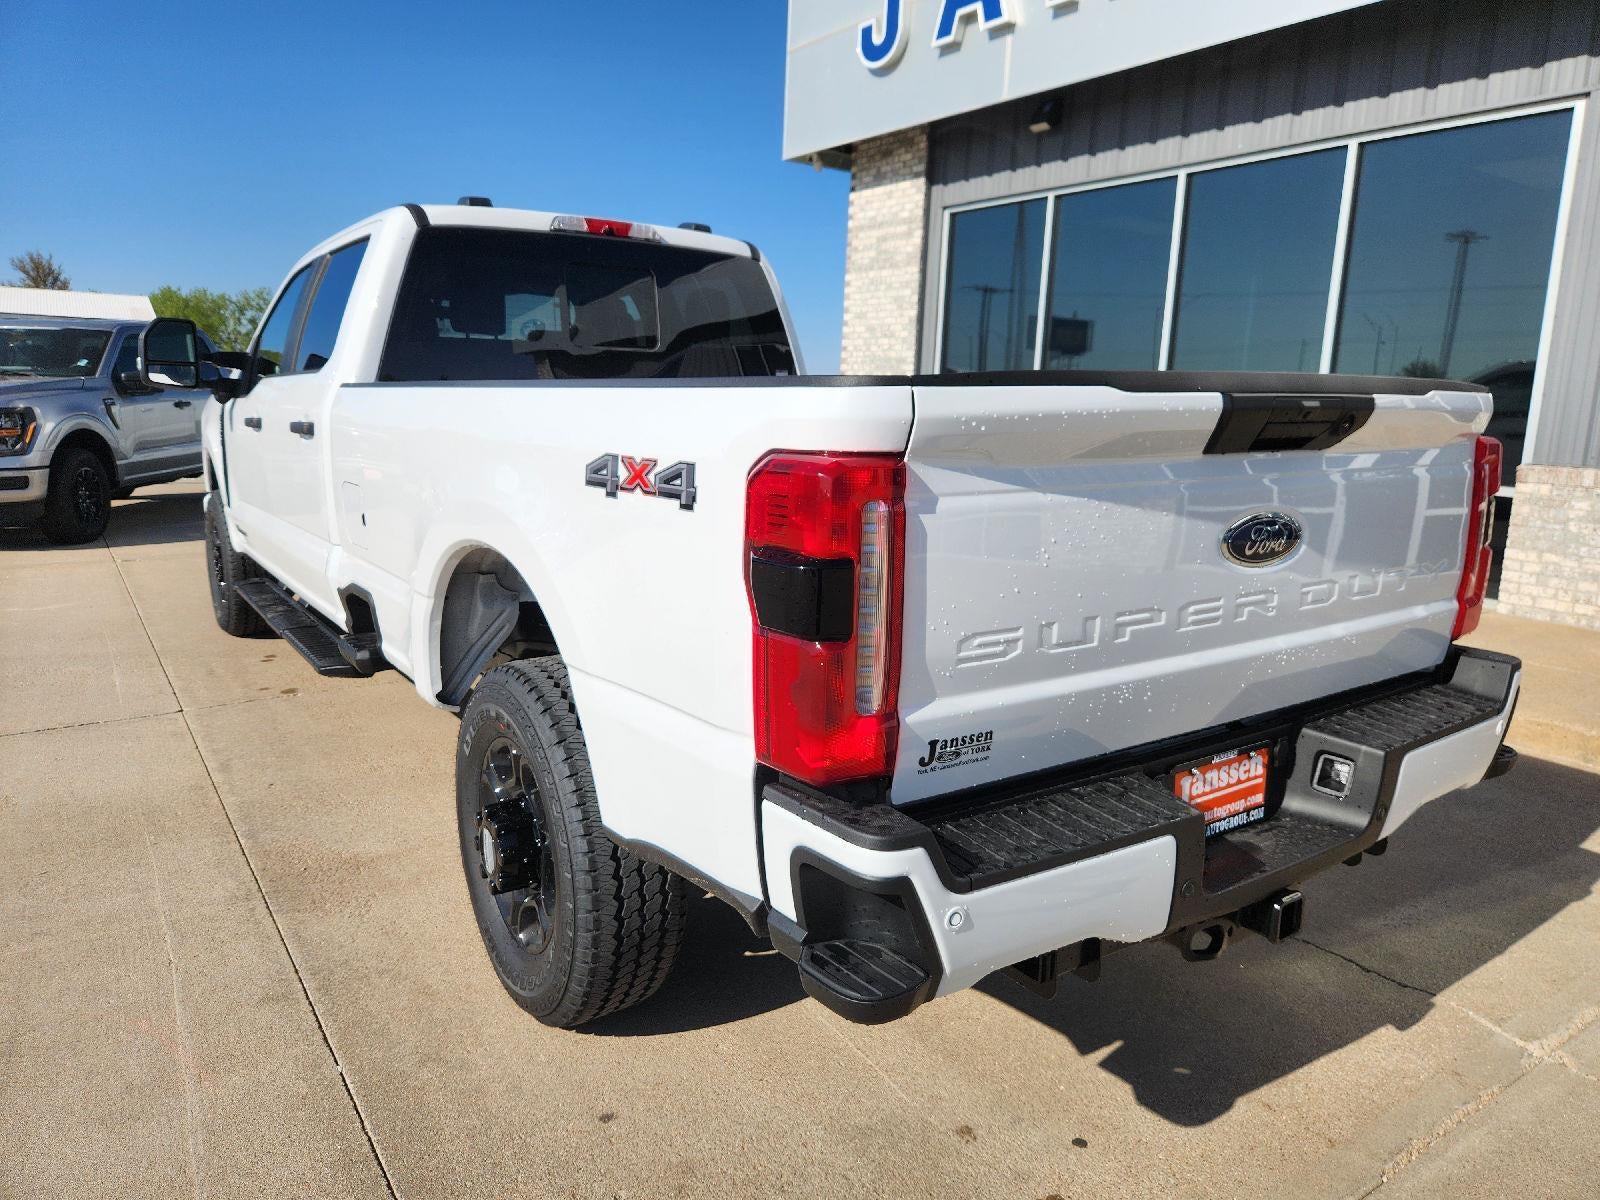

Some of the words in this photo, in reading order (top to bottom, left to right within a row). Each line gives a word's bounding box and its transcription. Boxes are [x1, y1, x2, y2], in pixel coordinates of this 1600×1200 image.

[1245, 524, 1288, 556] Ford
[956, 588, 1279, 668] SUPER
[1299, 558, 1449, 611] DUTY
[918, 730, 994, 767] Janssen
[971, 744, 992, 755] YORK
